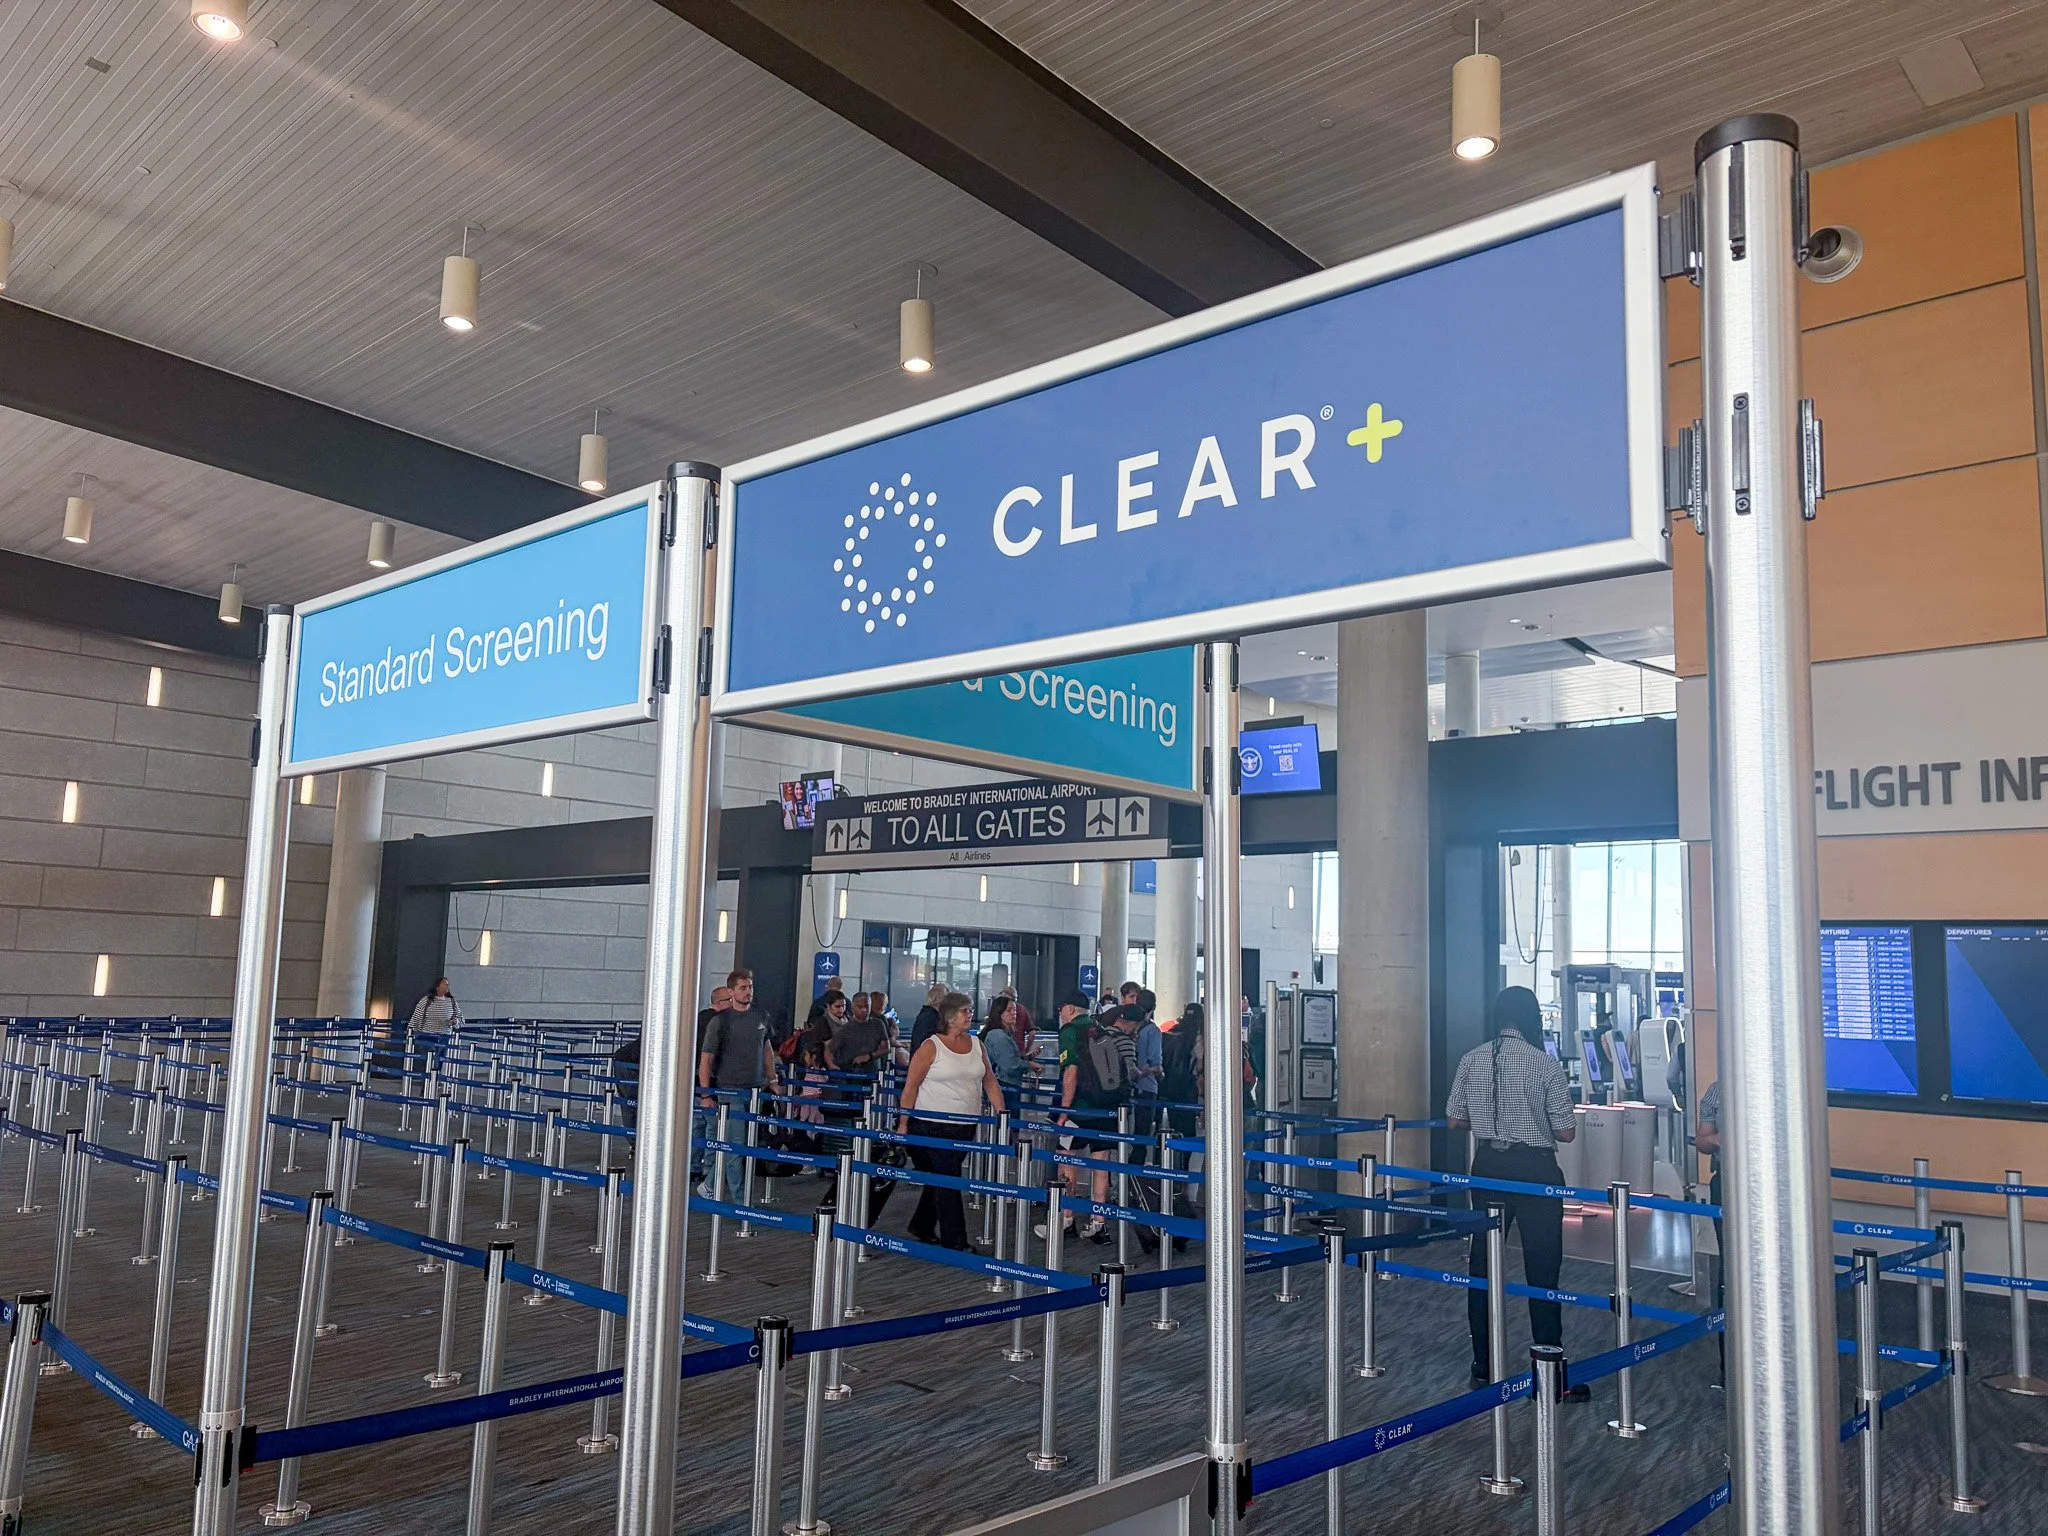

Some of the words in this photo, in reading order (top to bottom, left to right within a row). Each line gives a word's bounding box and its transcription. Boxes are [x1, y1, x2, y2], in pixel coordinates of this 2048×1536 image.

[320, 634, 435, 707] Standard
[444, 600, 609, 678] Screening
[864, 801, 907, 814] WELCOME
[910, 798, 922, 810] TO
[924, 793, 967, 809] BRADLEY
[970, 786, 1048, 805] INTERNATIONAL
[888, 814, 919, 845] TO
[924, 812, 968, 844] ALL
[976, 805, 1066, 840] GATES
[950, 852, 959, 861] All
[964, 851, 991, 861] Airlines
[1868, 1227, 1894, 1235] CLEAR
[985, 1263, 1001, 1272] BRADLEY
[1002, 1267, 1031, 1277] INTERNATIONAL
[1032, 1272, 1049, 1281] AIRPORT
[1452, 1276, 1470, 1284] CLEAR
[945, 1315, 965, 1324] BRADLEY
[966, 1309, 1001, 1320] INTERNATIONAL
[1002, 1305, 1021, 1314] AIRPORT
[1641, 1343, 1656, 1354] CLEAR
[510, 1393, 542, 1406] BRADLEY
[543, 1382, 598, 1399] INTERNATIONAL
[600, 1376, 624, 1388] AIRPOR
[1512, 1377, 1532, 1392] CLEAR
[1388, 1423, 1413, 1440] CLEAR
